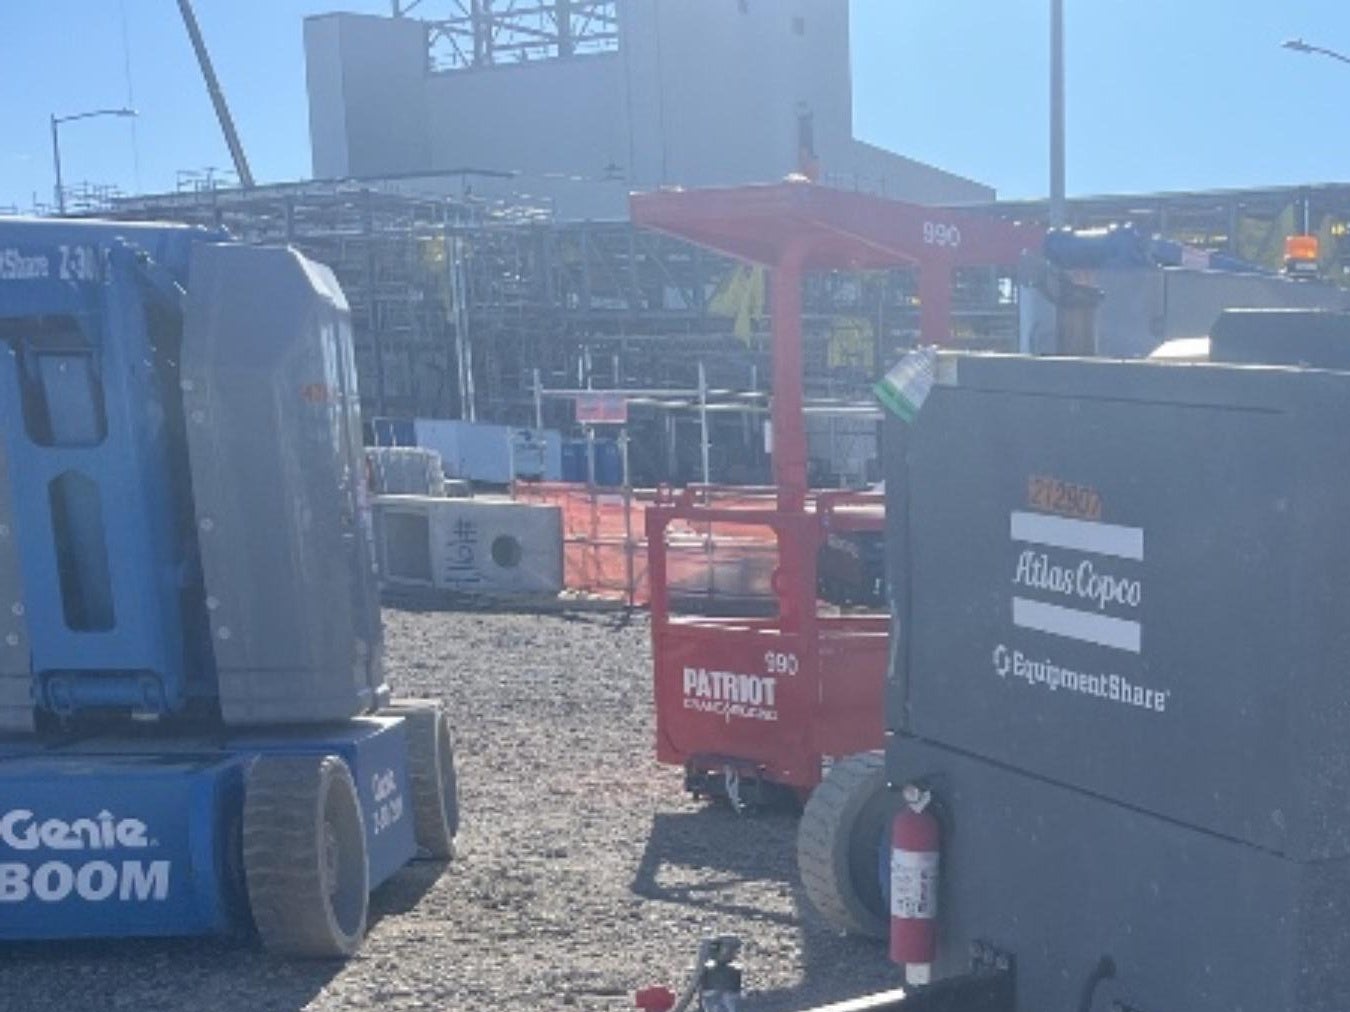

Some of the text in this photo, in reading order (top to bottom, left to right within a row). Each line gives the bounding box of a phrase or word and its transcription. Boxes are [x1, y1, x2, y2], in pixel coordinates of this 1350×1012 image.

[683, 667, 778, 706] PATRIOT
[1012, 650, 1166, 712] EquipmentShare
[0, 808, 149, 850] Genie
[0, 860, 171, 901] BOOM
